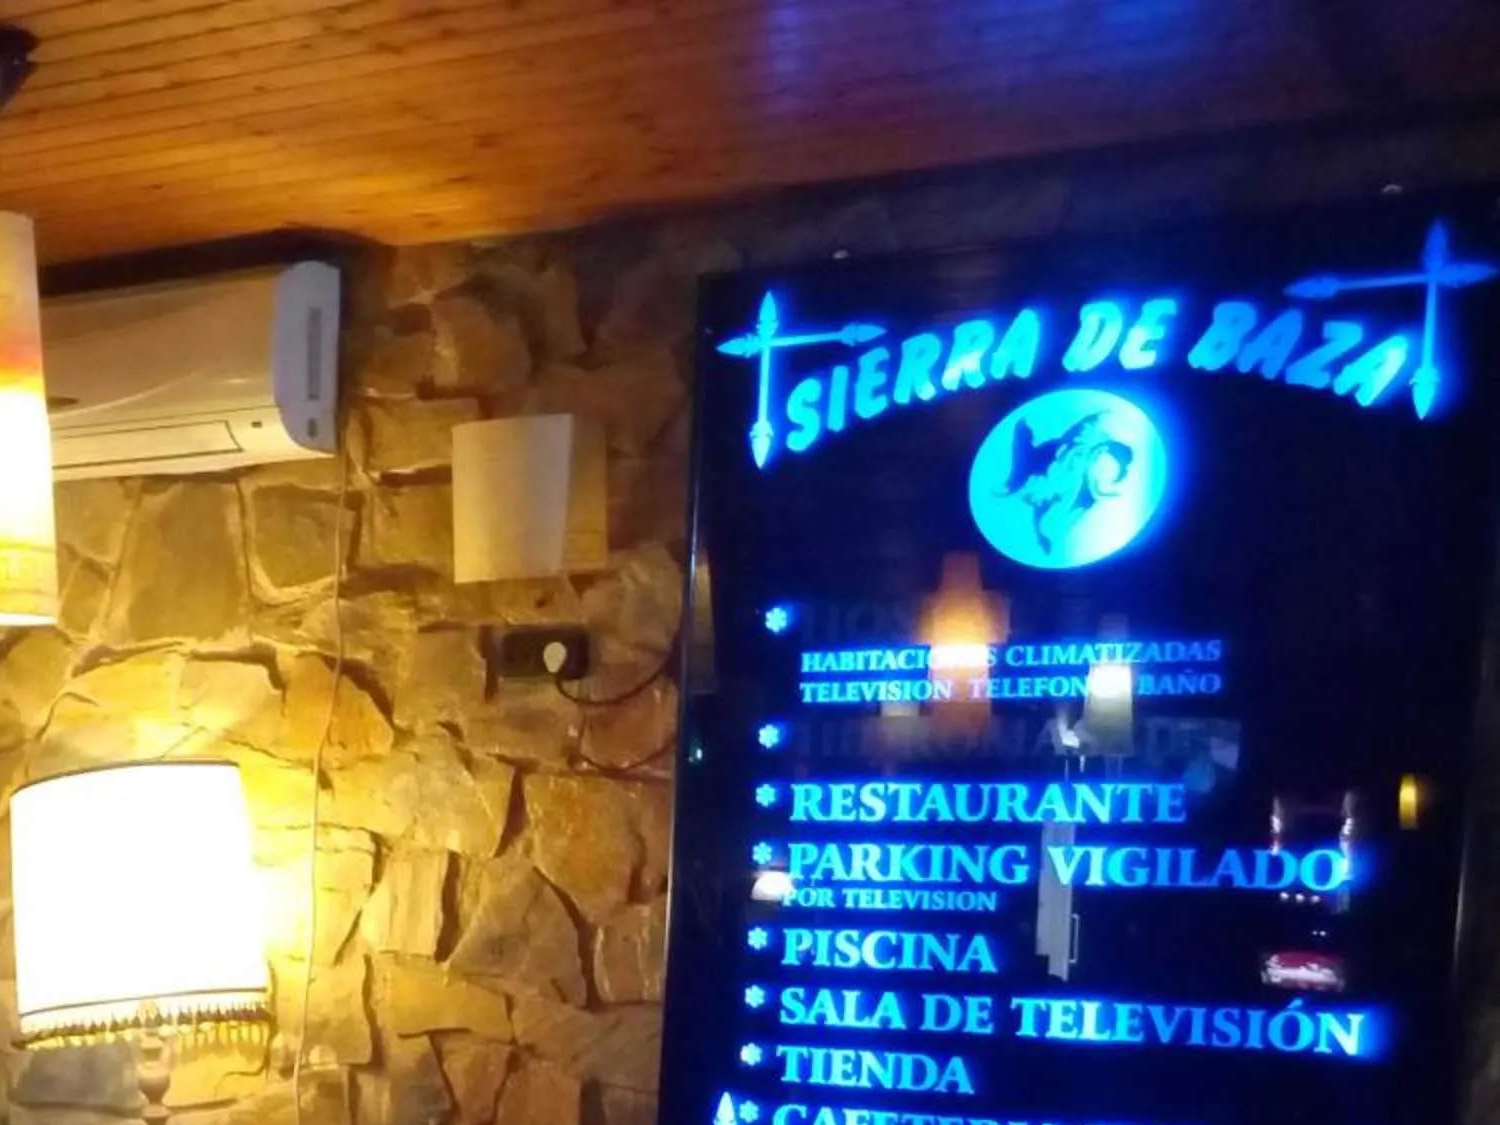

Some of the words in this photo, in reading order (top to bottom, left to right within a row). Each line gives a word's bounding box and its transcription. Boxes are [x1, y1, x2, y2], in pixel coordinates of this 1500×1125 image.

[786, 307, 1041, 453] SIERRA
[1063, 298, 1179, 373] DE
[1186, 301, 1412, 408] BAZA
[801, 640, 996, 672] HABITACIS
[1006, 639, 1221, 667] CLIMATIZADAS
[800, 679, 952, 702] TELEVISION
[967, 673, 1112, 699] TELEFON
[1138, 668, 1222, 696] BAÑO
[789, 782, 1186, 824] RESTAURANTE
[788, 843, 1030, 886] PARKING
[1046, 845, 1348, 892] VIGILADO
[782, 887, 836, 908] POR
[842, 888, 997, 912] TELEVISION
[781, 928, 997, 974] PISCINA
[779, 986, 905, 1029] SALA
[921, 993, 993, 1034] DE
[1012, 998, 1364, 1056] TELEVISIÓN
[776, 1045, 975, 1094] TIENDA
